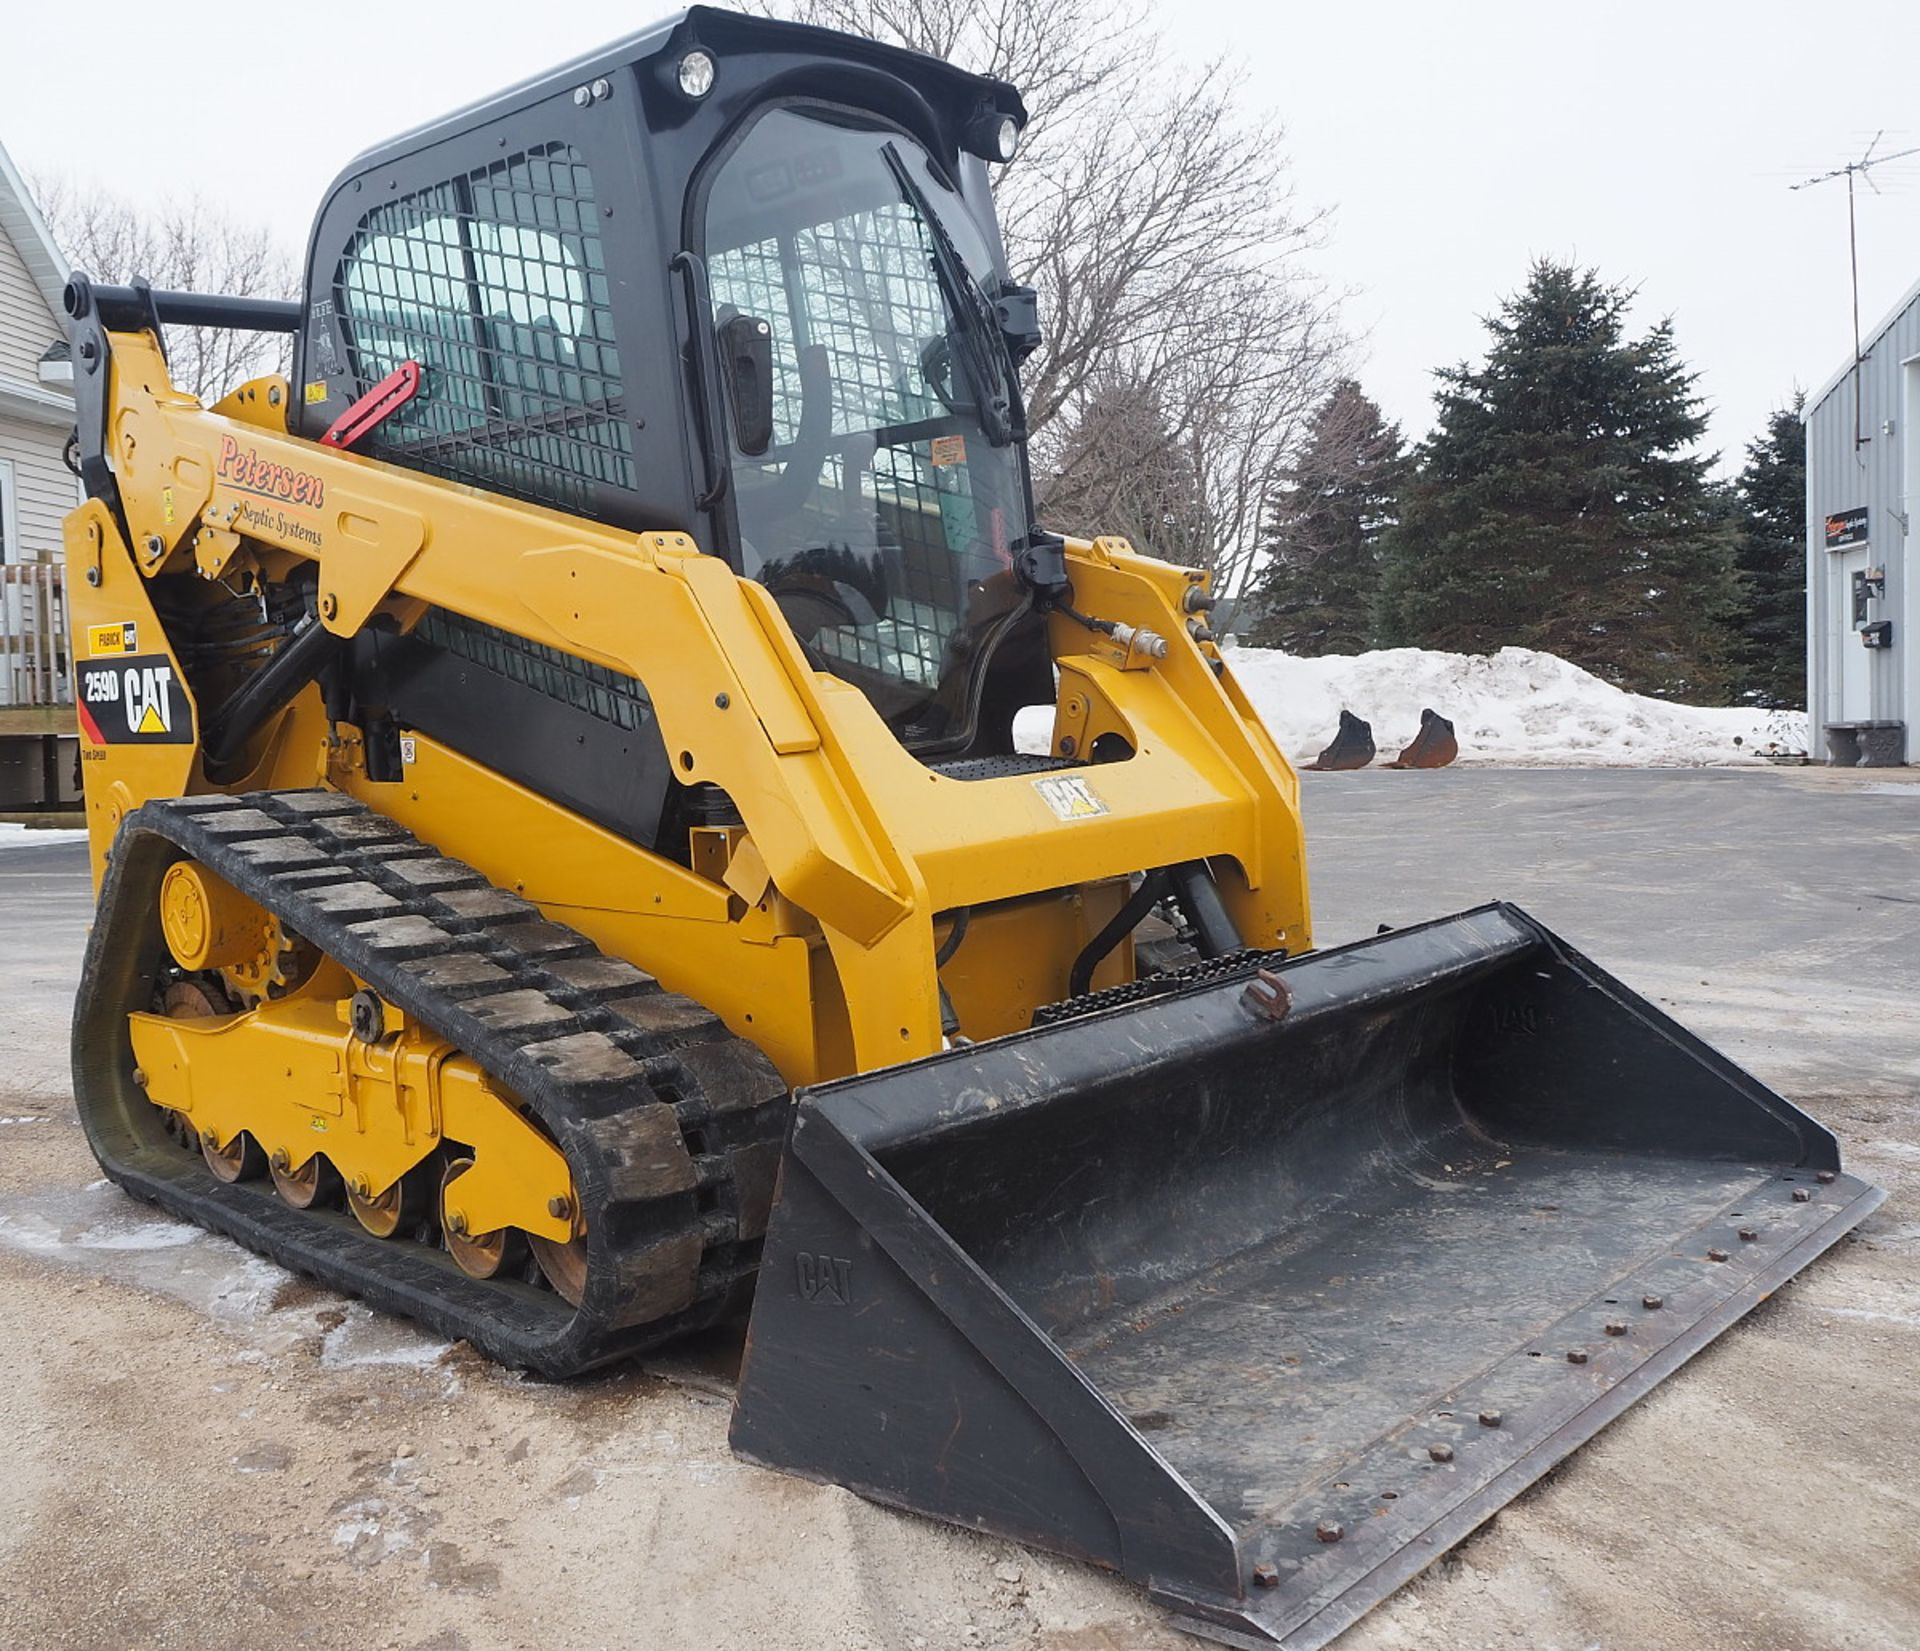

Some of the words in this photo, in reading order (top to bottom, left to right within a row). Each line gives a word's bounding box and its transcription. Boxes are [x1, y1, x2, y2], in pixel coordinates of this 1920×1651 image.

[217, 433, 324, 509] Petersen
[242, 500, 274, 530] Septic
[275, 512, 323, 546] Systems
[85, 670, 119, 702] 259D
[124, 666, 171, 734] CAT
[1040, 777, 1102, 817] CAT
[796, 1251, 852, 1307] CAT
